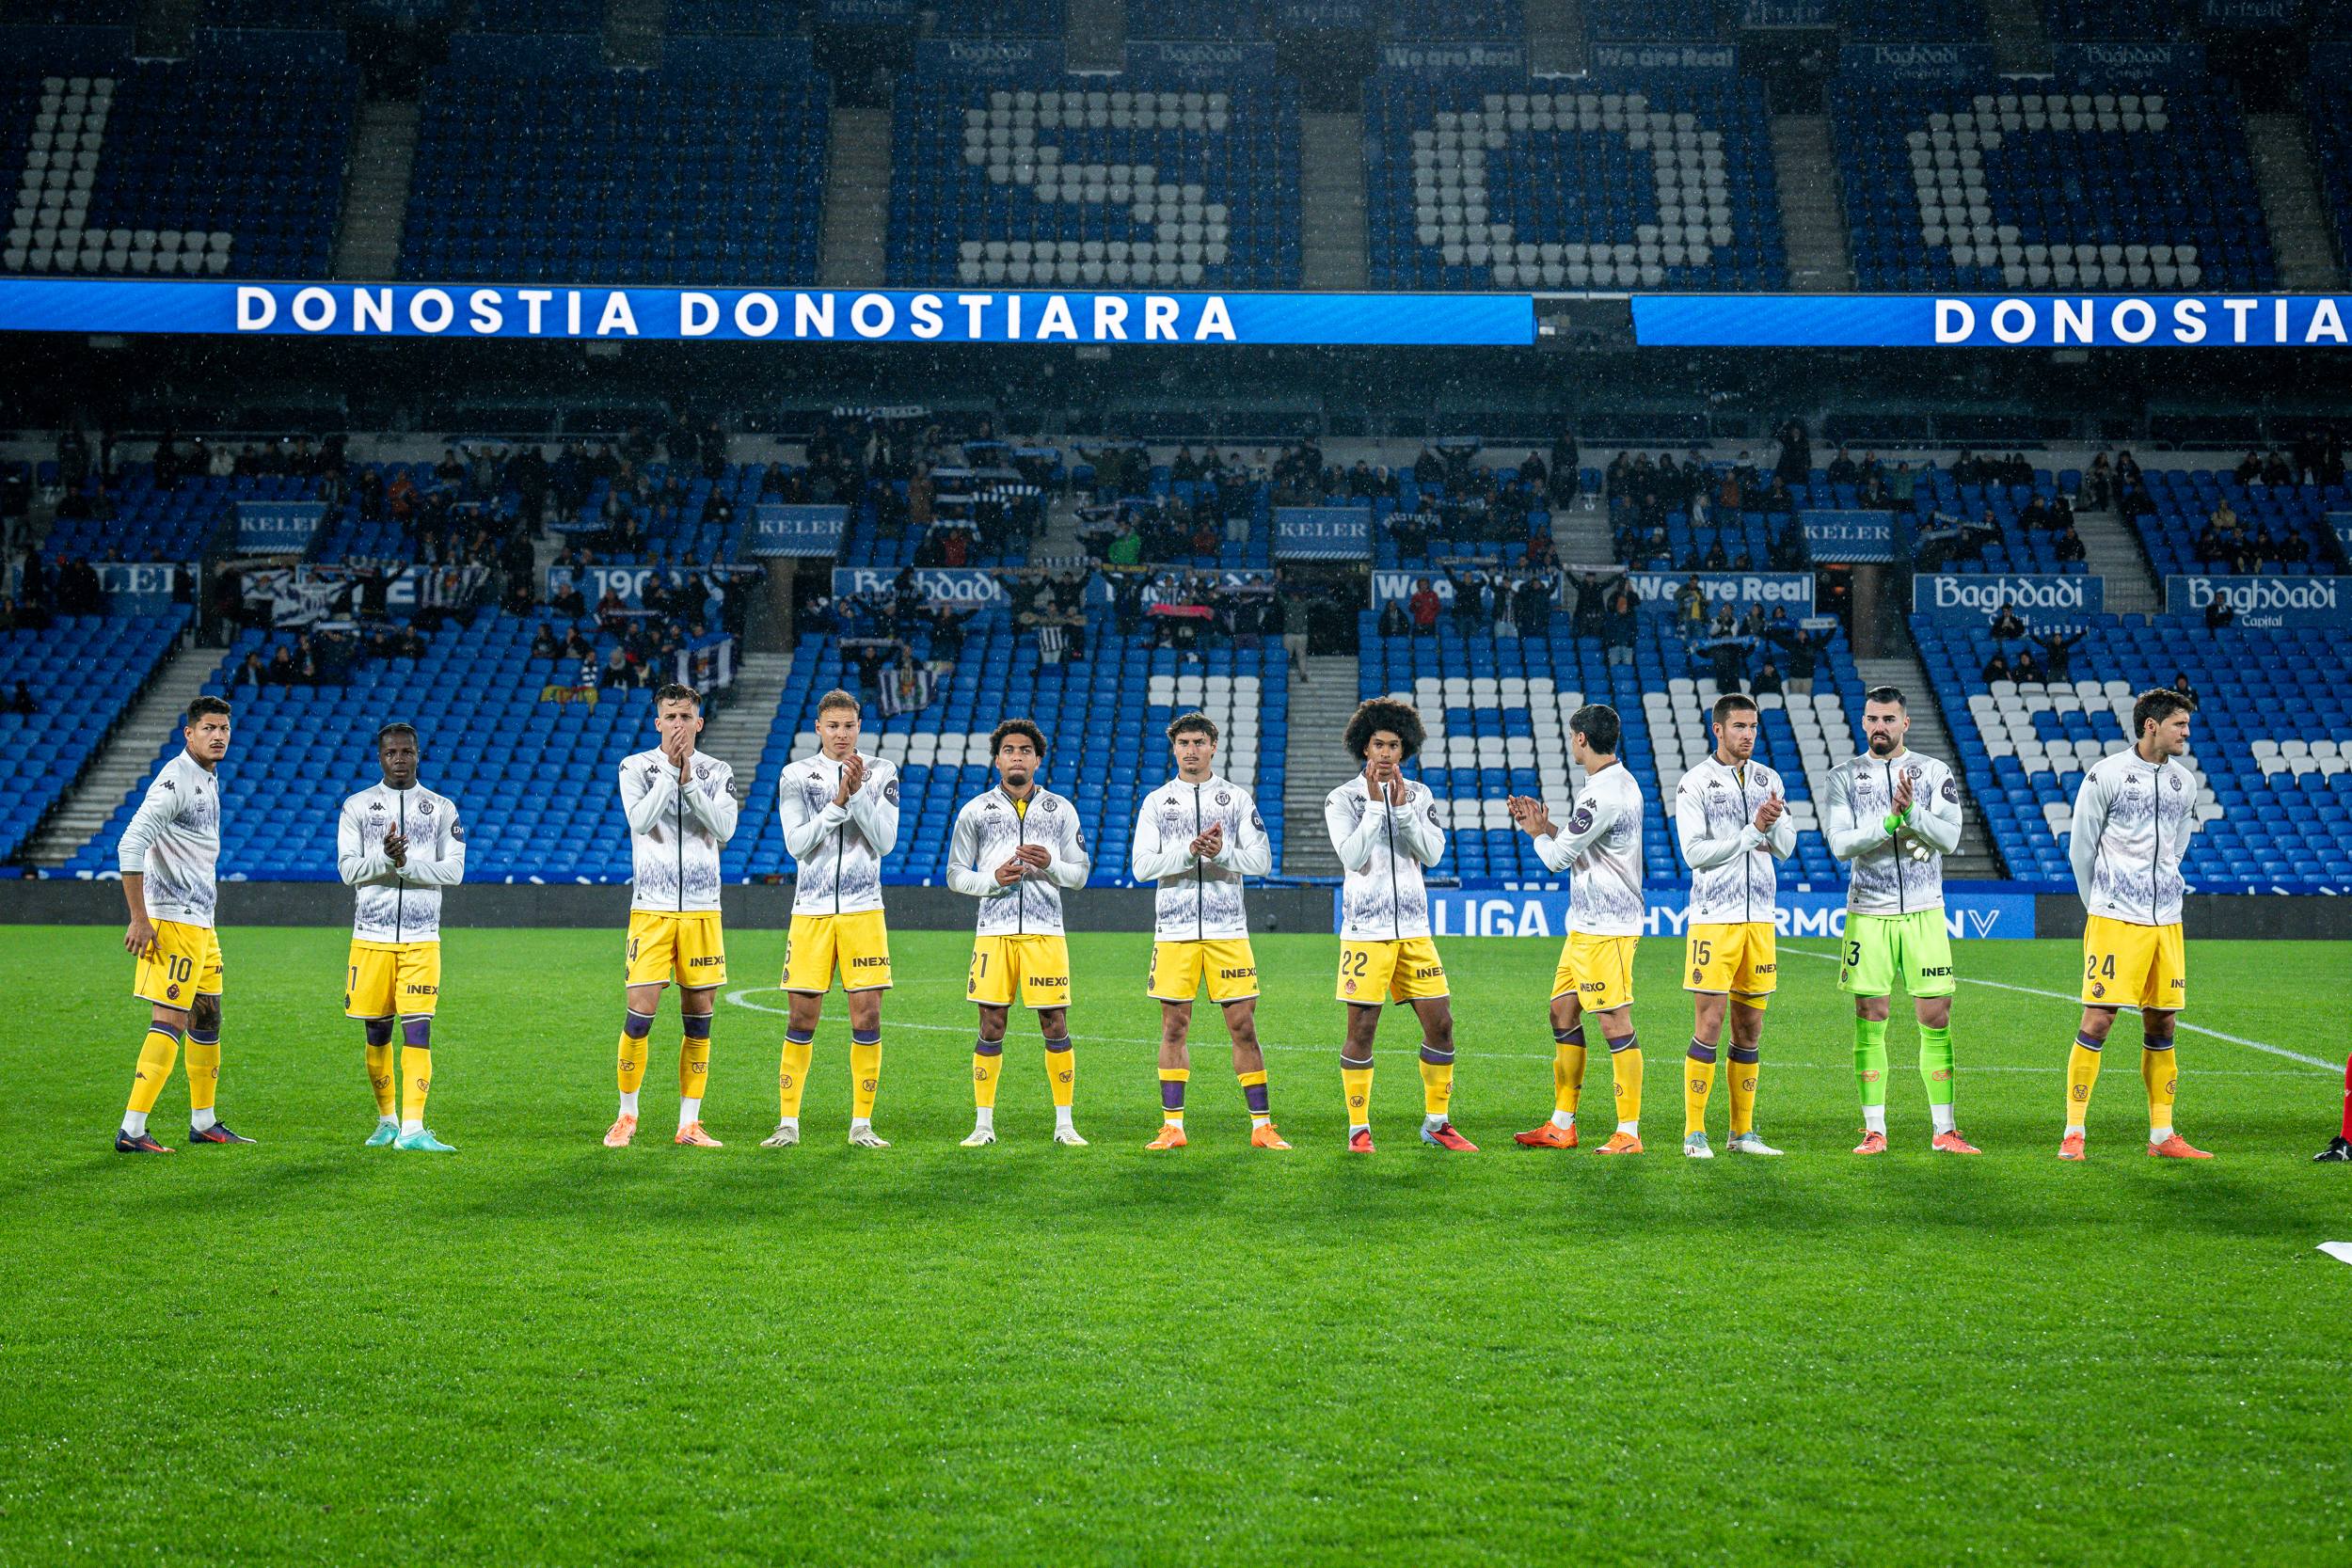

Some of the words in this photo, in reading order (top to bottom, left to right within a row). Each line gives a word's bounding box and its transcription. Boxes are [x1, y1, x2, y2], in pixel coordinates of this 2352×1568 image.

[237, 287, 639, 335] DONOSTIA
[680, 293, 1237, 341] DONOSTIARRA
[1935, 299, 2348, 343] DONOSTIA
[1279, 522, 1367, 538] KELER
[1804, 526, 1891, 542] KELER
[1629, 577, 1681, 601] We
[1742, 577, 1810, 601] Real
[1934, 577, 2083, 613] Baghdadi
[2187, 578, 2336, 614] Baghdadi
[2242, 614, 2282, 628] Capital
[1342, 950, 1368, 977] 22
[1692, 939, 1711, 966] 15
[168, 954, 193, 983] 10
[1415, 966, 1444, 979] INEX
[1921, 966, 1952, 977] INEX
[2087, 954, 2115, 980] 24
[406, 984, 439, 996] INEX
[1029, 976, 1069, 987] INEXO
